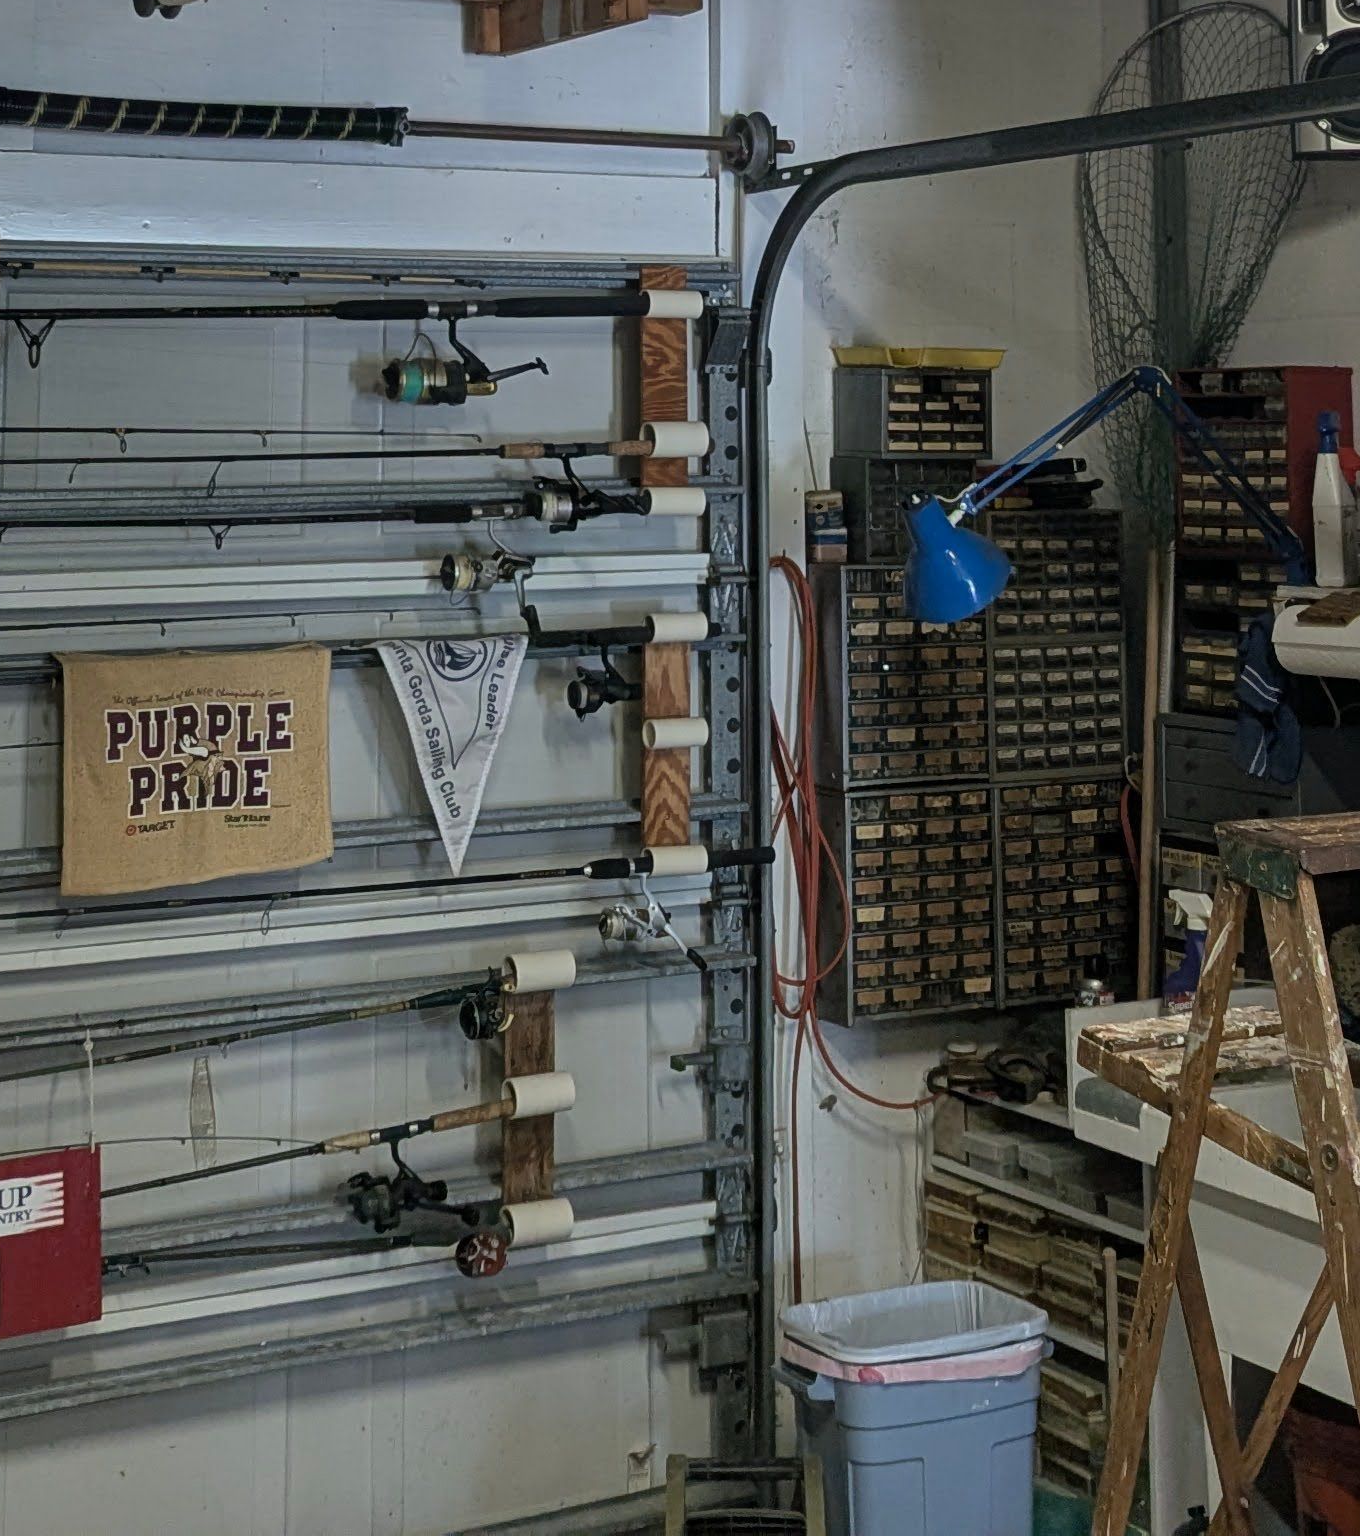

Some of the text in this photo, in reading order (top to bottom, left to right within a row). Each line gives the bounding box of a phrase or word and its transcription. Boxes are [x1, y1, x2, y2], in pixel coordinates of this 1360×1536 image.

[104, 699, 294, 763] PURPLE
[485, 672, 506, 731] Leader
[408, 674, 433, 726] Gorda
[425, 726, 447, 781] Sailing
[440, 780, 462, 820] Club
[138, 820, 176, 834] TARGET
